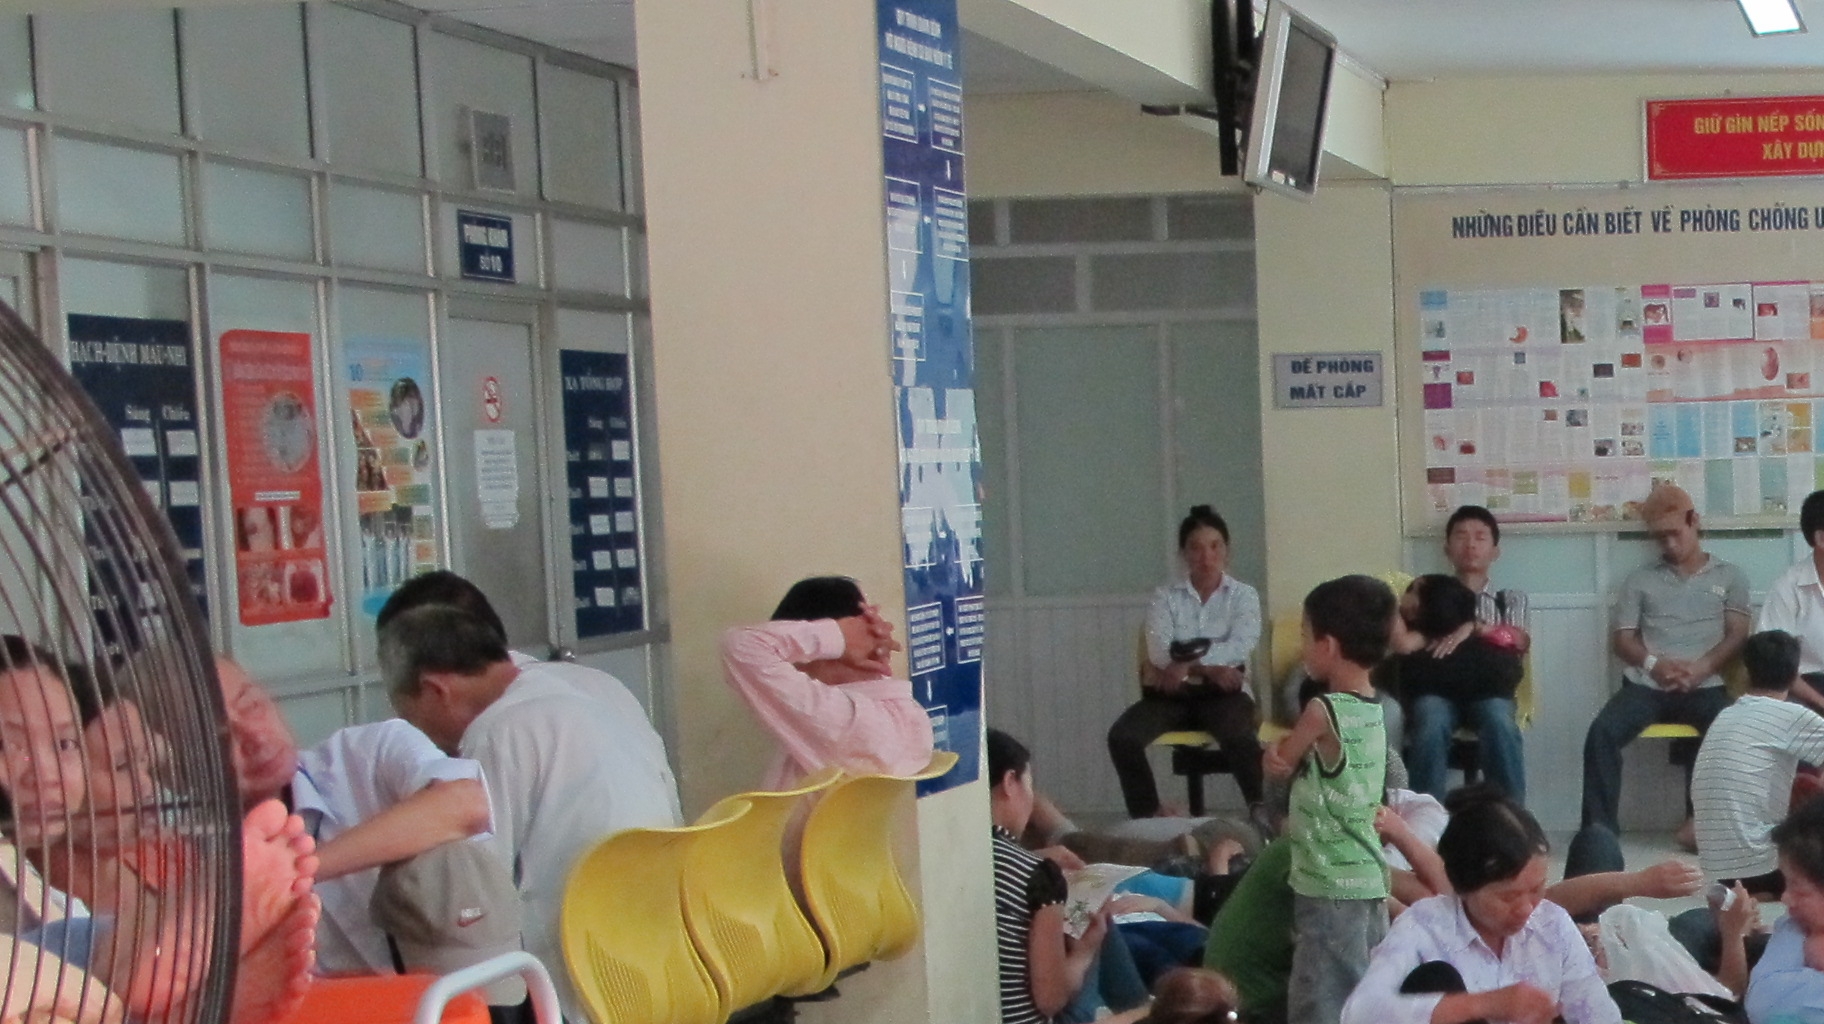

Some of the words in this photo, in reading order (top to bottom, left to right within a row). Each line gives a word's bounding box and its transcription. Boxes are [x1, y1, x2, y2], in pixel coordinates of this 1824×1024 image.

[1694, 113, 1722, 134] GIỮ
[1725, 113, 1752, 133] GÌN
[1757, 109, 1789, 132] NẾP
[1762, 139, 1793, 160] XÂY
[1452, 208, 1513, 238] NHỮNG
[1517, 209, 1557, 237] ĐIỀU
[1563, 206, 1599, 235] CẦN
[1605, 205, 1642, 234] BIẾT
[1651, 204, 1675, 233] VỀ
[1680, 203, 1740, 232] PHÒNG
[1749, 202, 1809, 230] CHỐNG
[1317, 357, 1374, 374] PHÒNG
